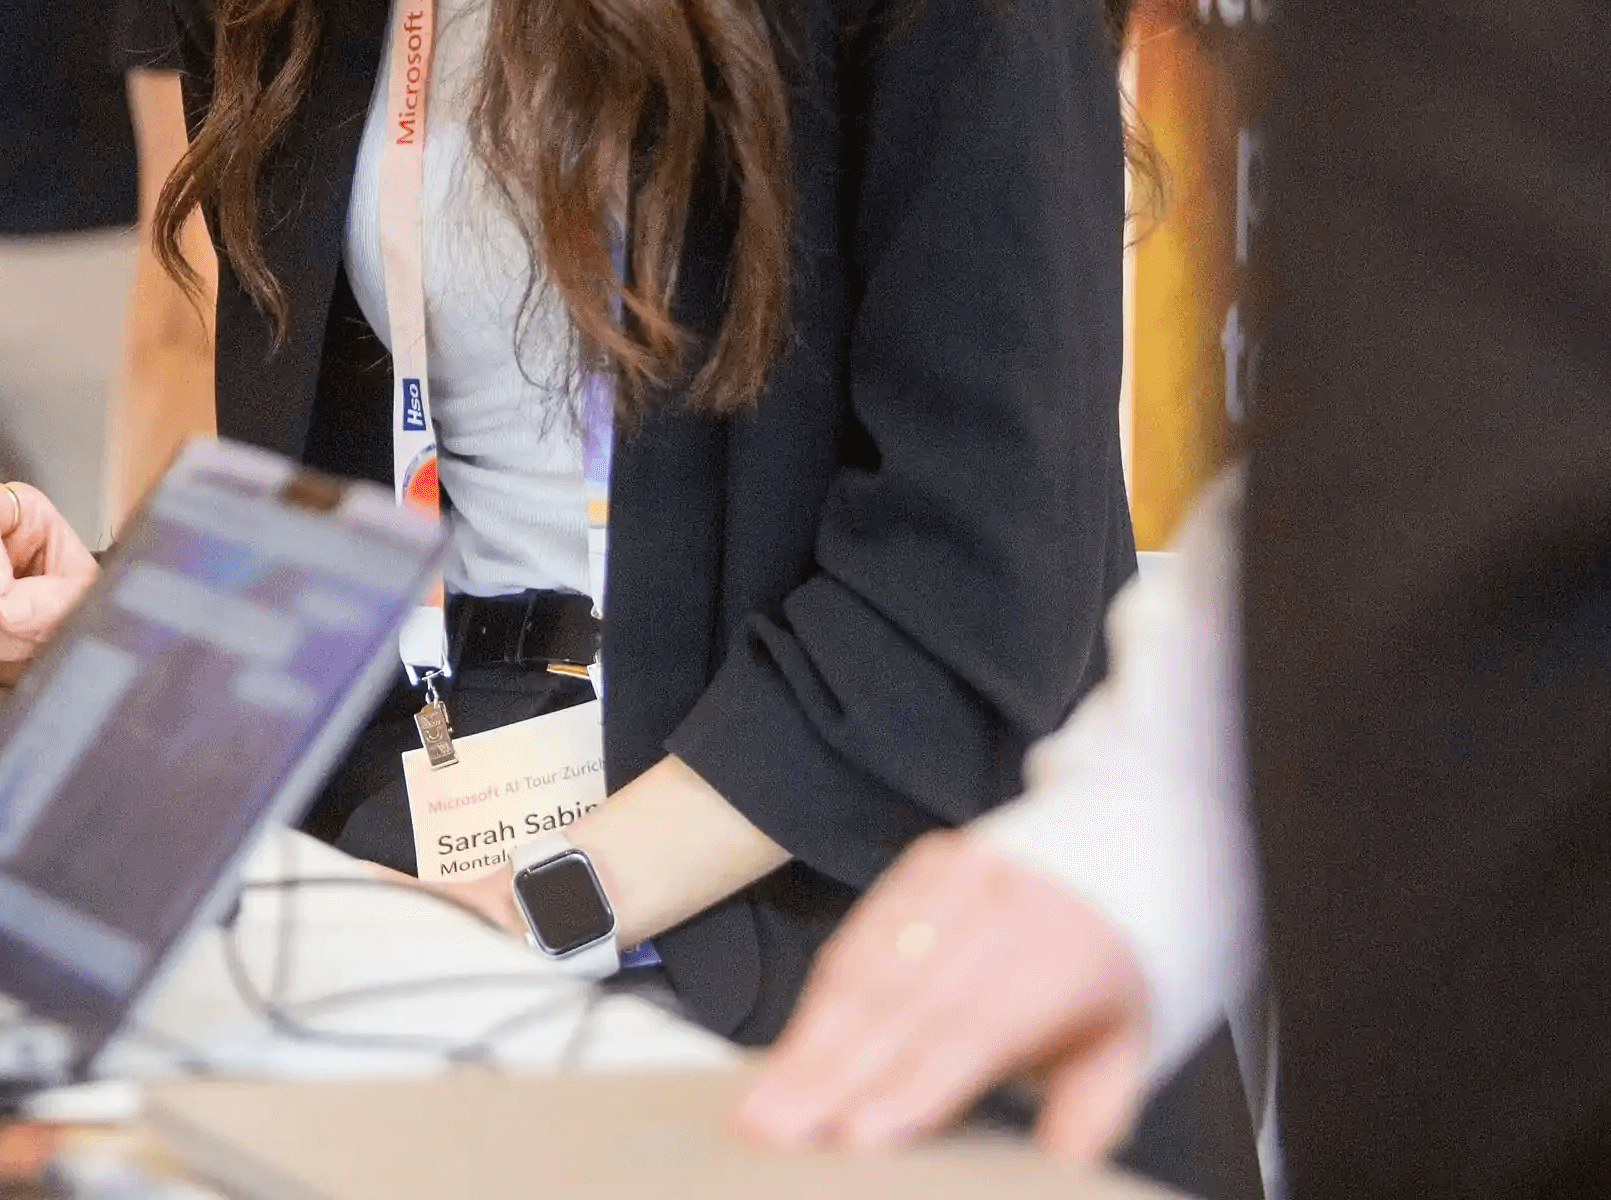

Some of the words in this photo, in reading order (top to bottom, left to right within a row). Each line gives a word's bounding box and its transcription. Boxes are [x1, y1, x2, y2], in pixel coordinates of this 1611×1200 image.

[396, 10, 424, 146] Microsoft
[427, 785, 500, 815] Microsoft
[504, 781, 520, 797] AI
[524, 771, 558, 790] Tour
[437, 820, 516, 856] Sarah
[440, 847, 511, 877] Montal
